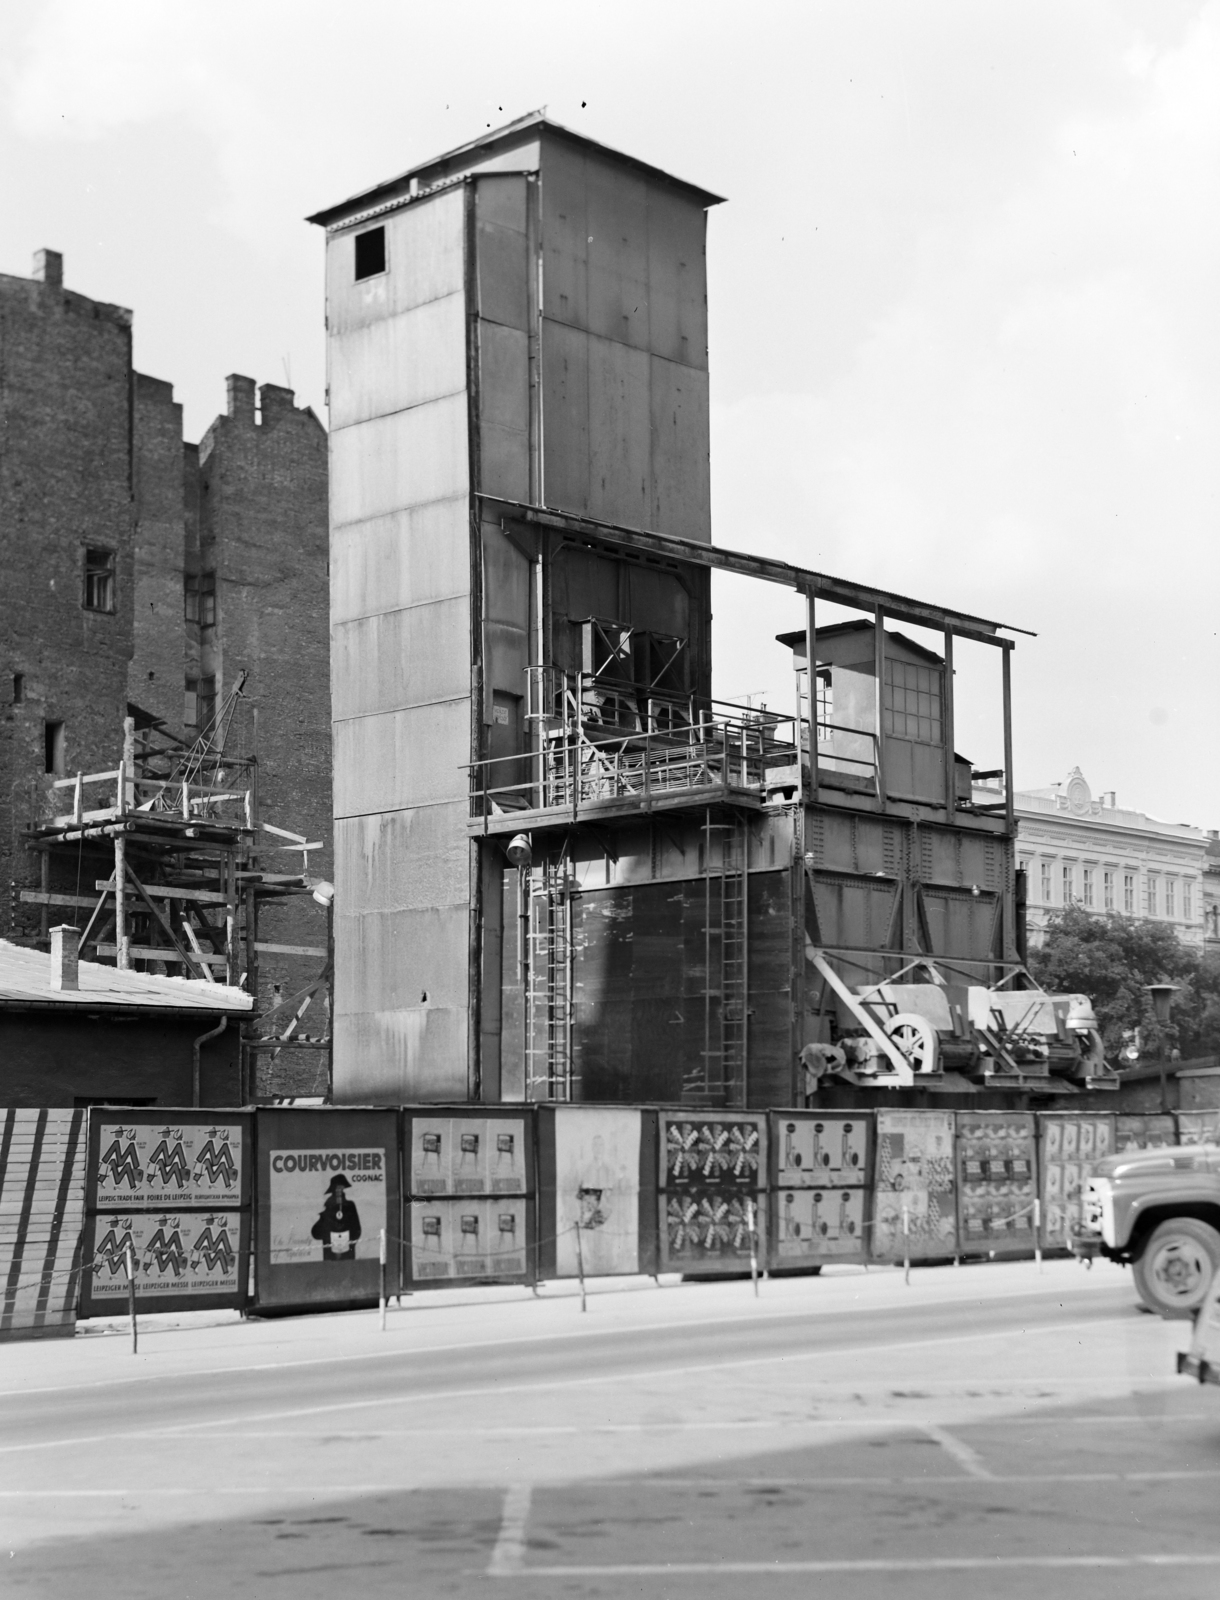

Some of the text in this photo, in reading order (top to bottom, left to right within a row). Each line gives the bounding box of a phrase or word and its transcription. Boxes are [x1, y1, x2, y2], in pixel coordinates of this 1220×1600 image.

[272, 1153, 382, 1173] COURVOISIER
[351, 1174, 383, 1182] COGNAC
[93, 1284, 121, 1292] LEIPZIGER
[123, 1283, 141, 1291] MSE
[143, 1282, 170, 1290] LEIPZIGER
